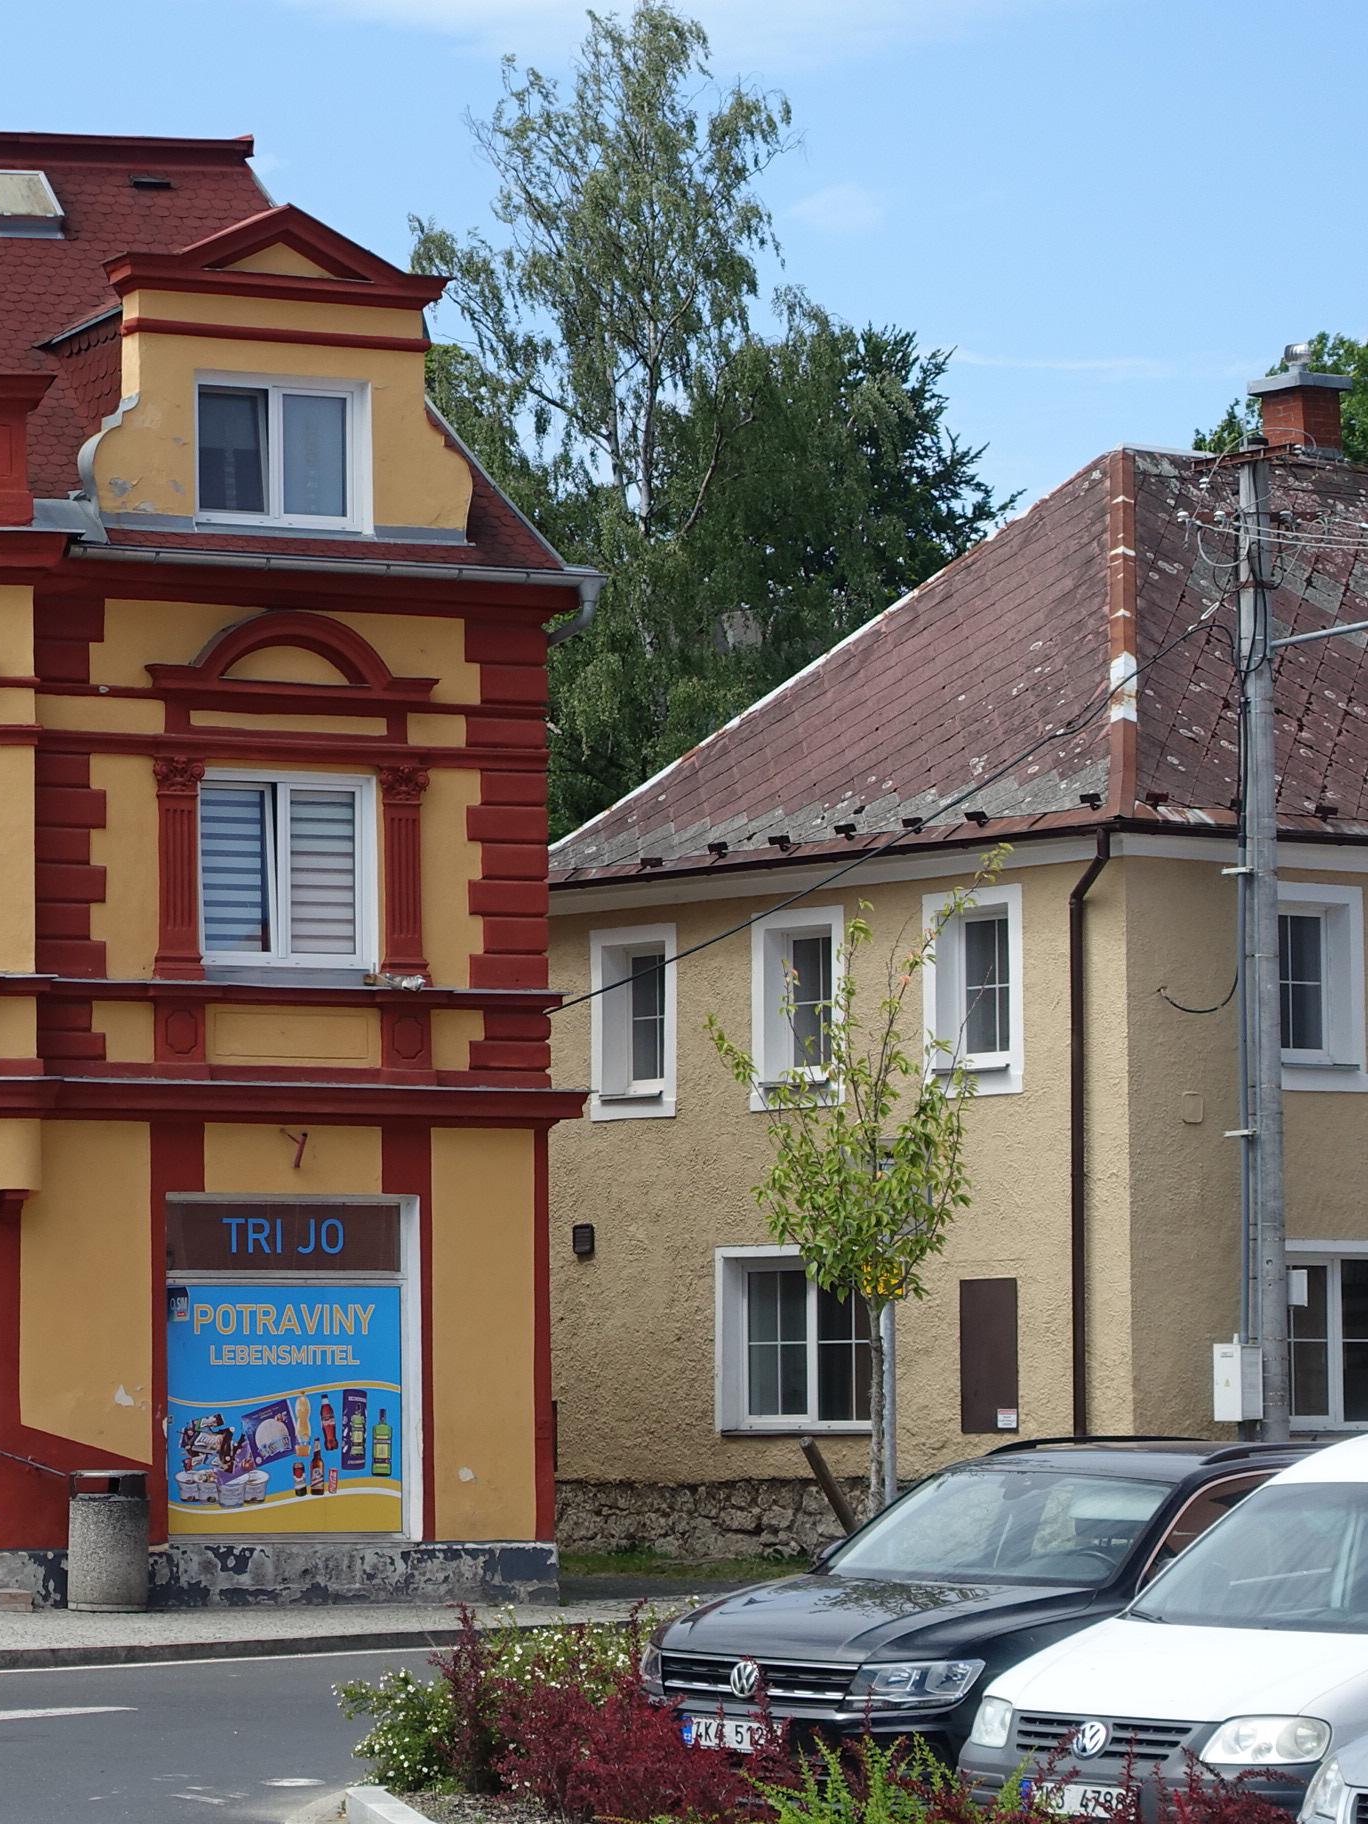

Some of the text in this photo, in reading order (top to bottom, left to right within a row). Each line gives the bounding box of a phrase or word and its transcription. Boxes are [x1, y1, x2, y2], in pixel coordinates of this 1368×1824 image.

[221, 1217, 344, 1254] TRI JO
[193, 1303, 375, 1335] POTRAVINY
[210, 1345, 360, 1366] LEBENSMITTEL
